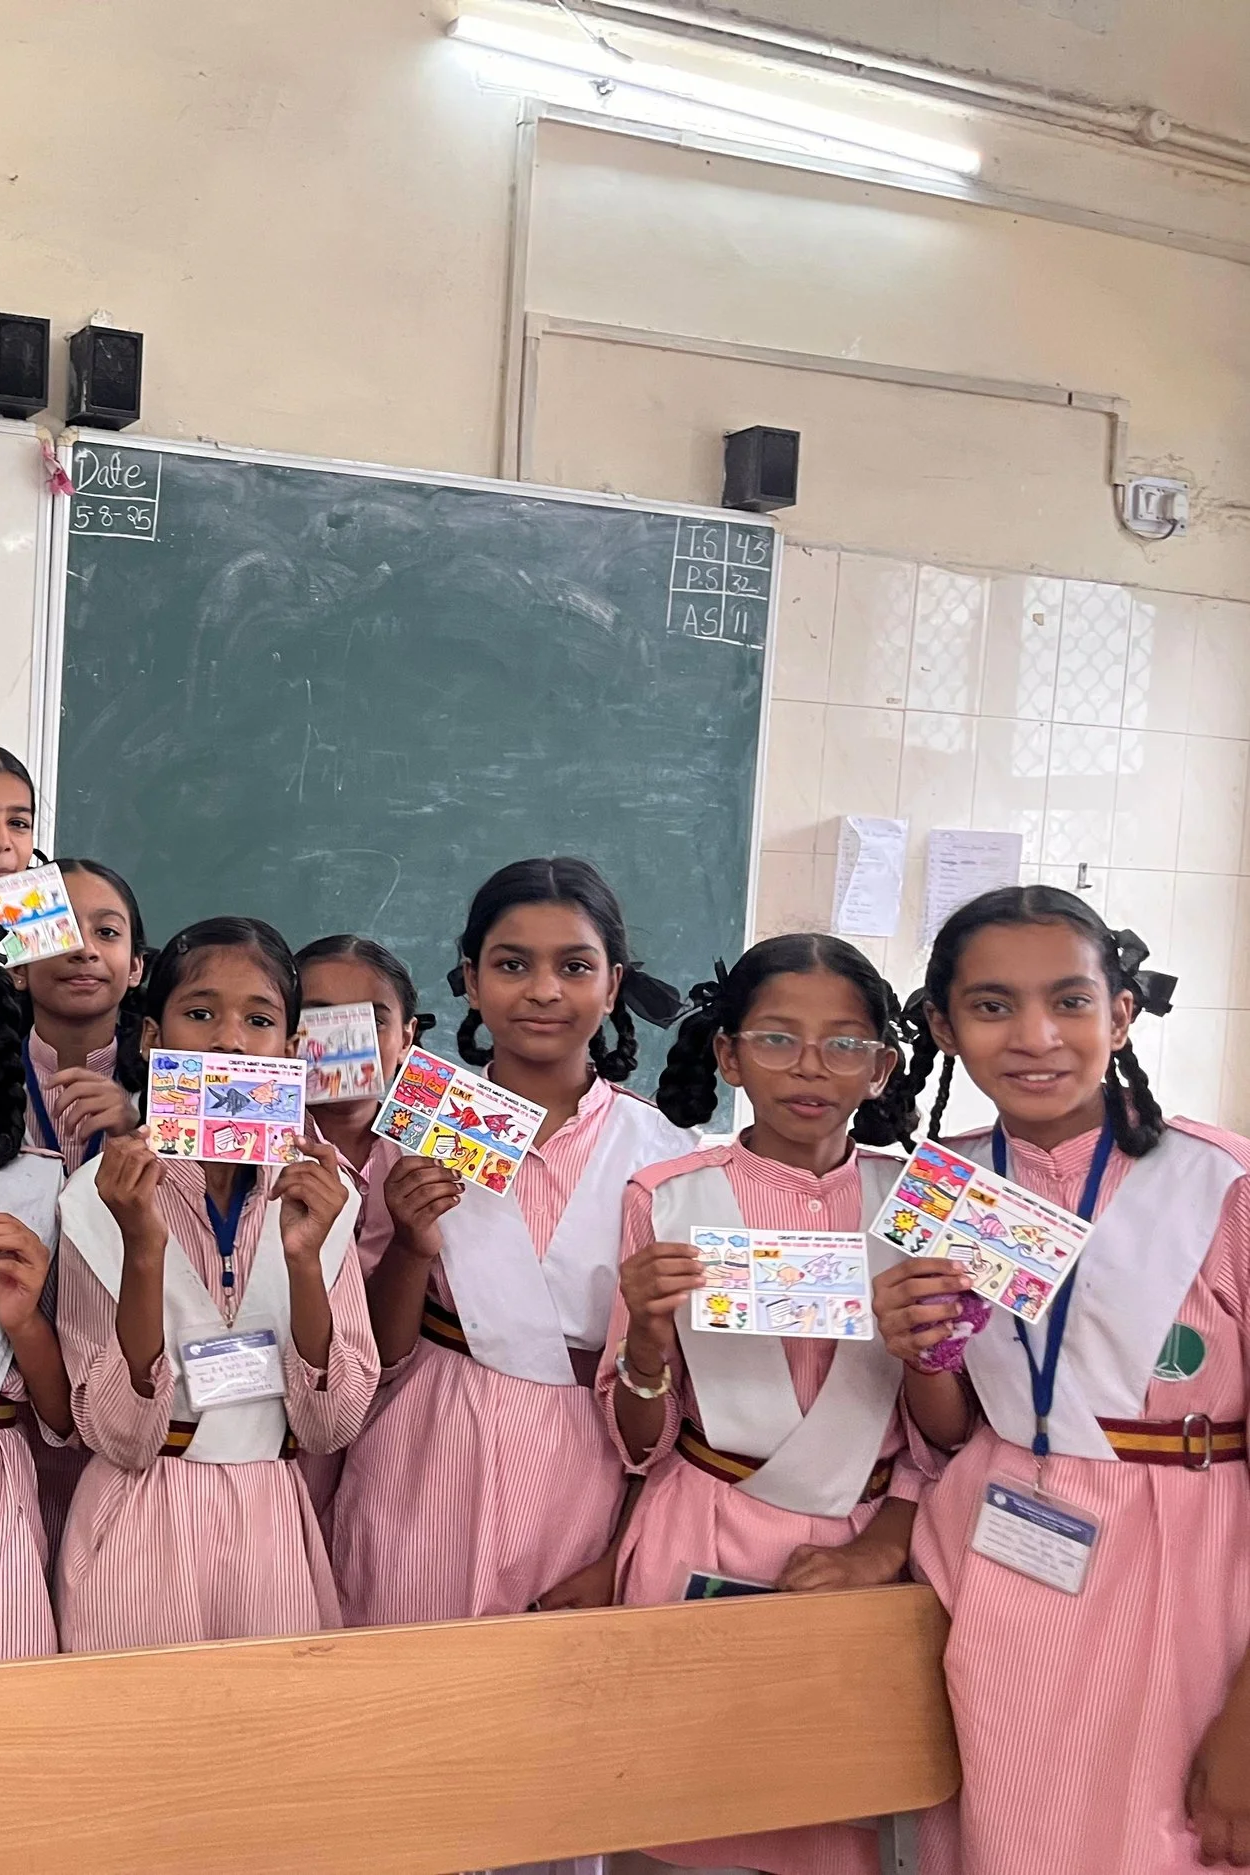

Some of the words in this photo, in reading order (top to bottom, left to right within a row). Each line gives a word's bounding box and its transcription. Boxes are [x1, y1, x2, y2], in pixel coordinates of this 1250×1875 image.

[75, 448, 146, 491] Date
[74, 505, 151, 530] 5-8-25
[686, 565, 718, 591] P.S
